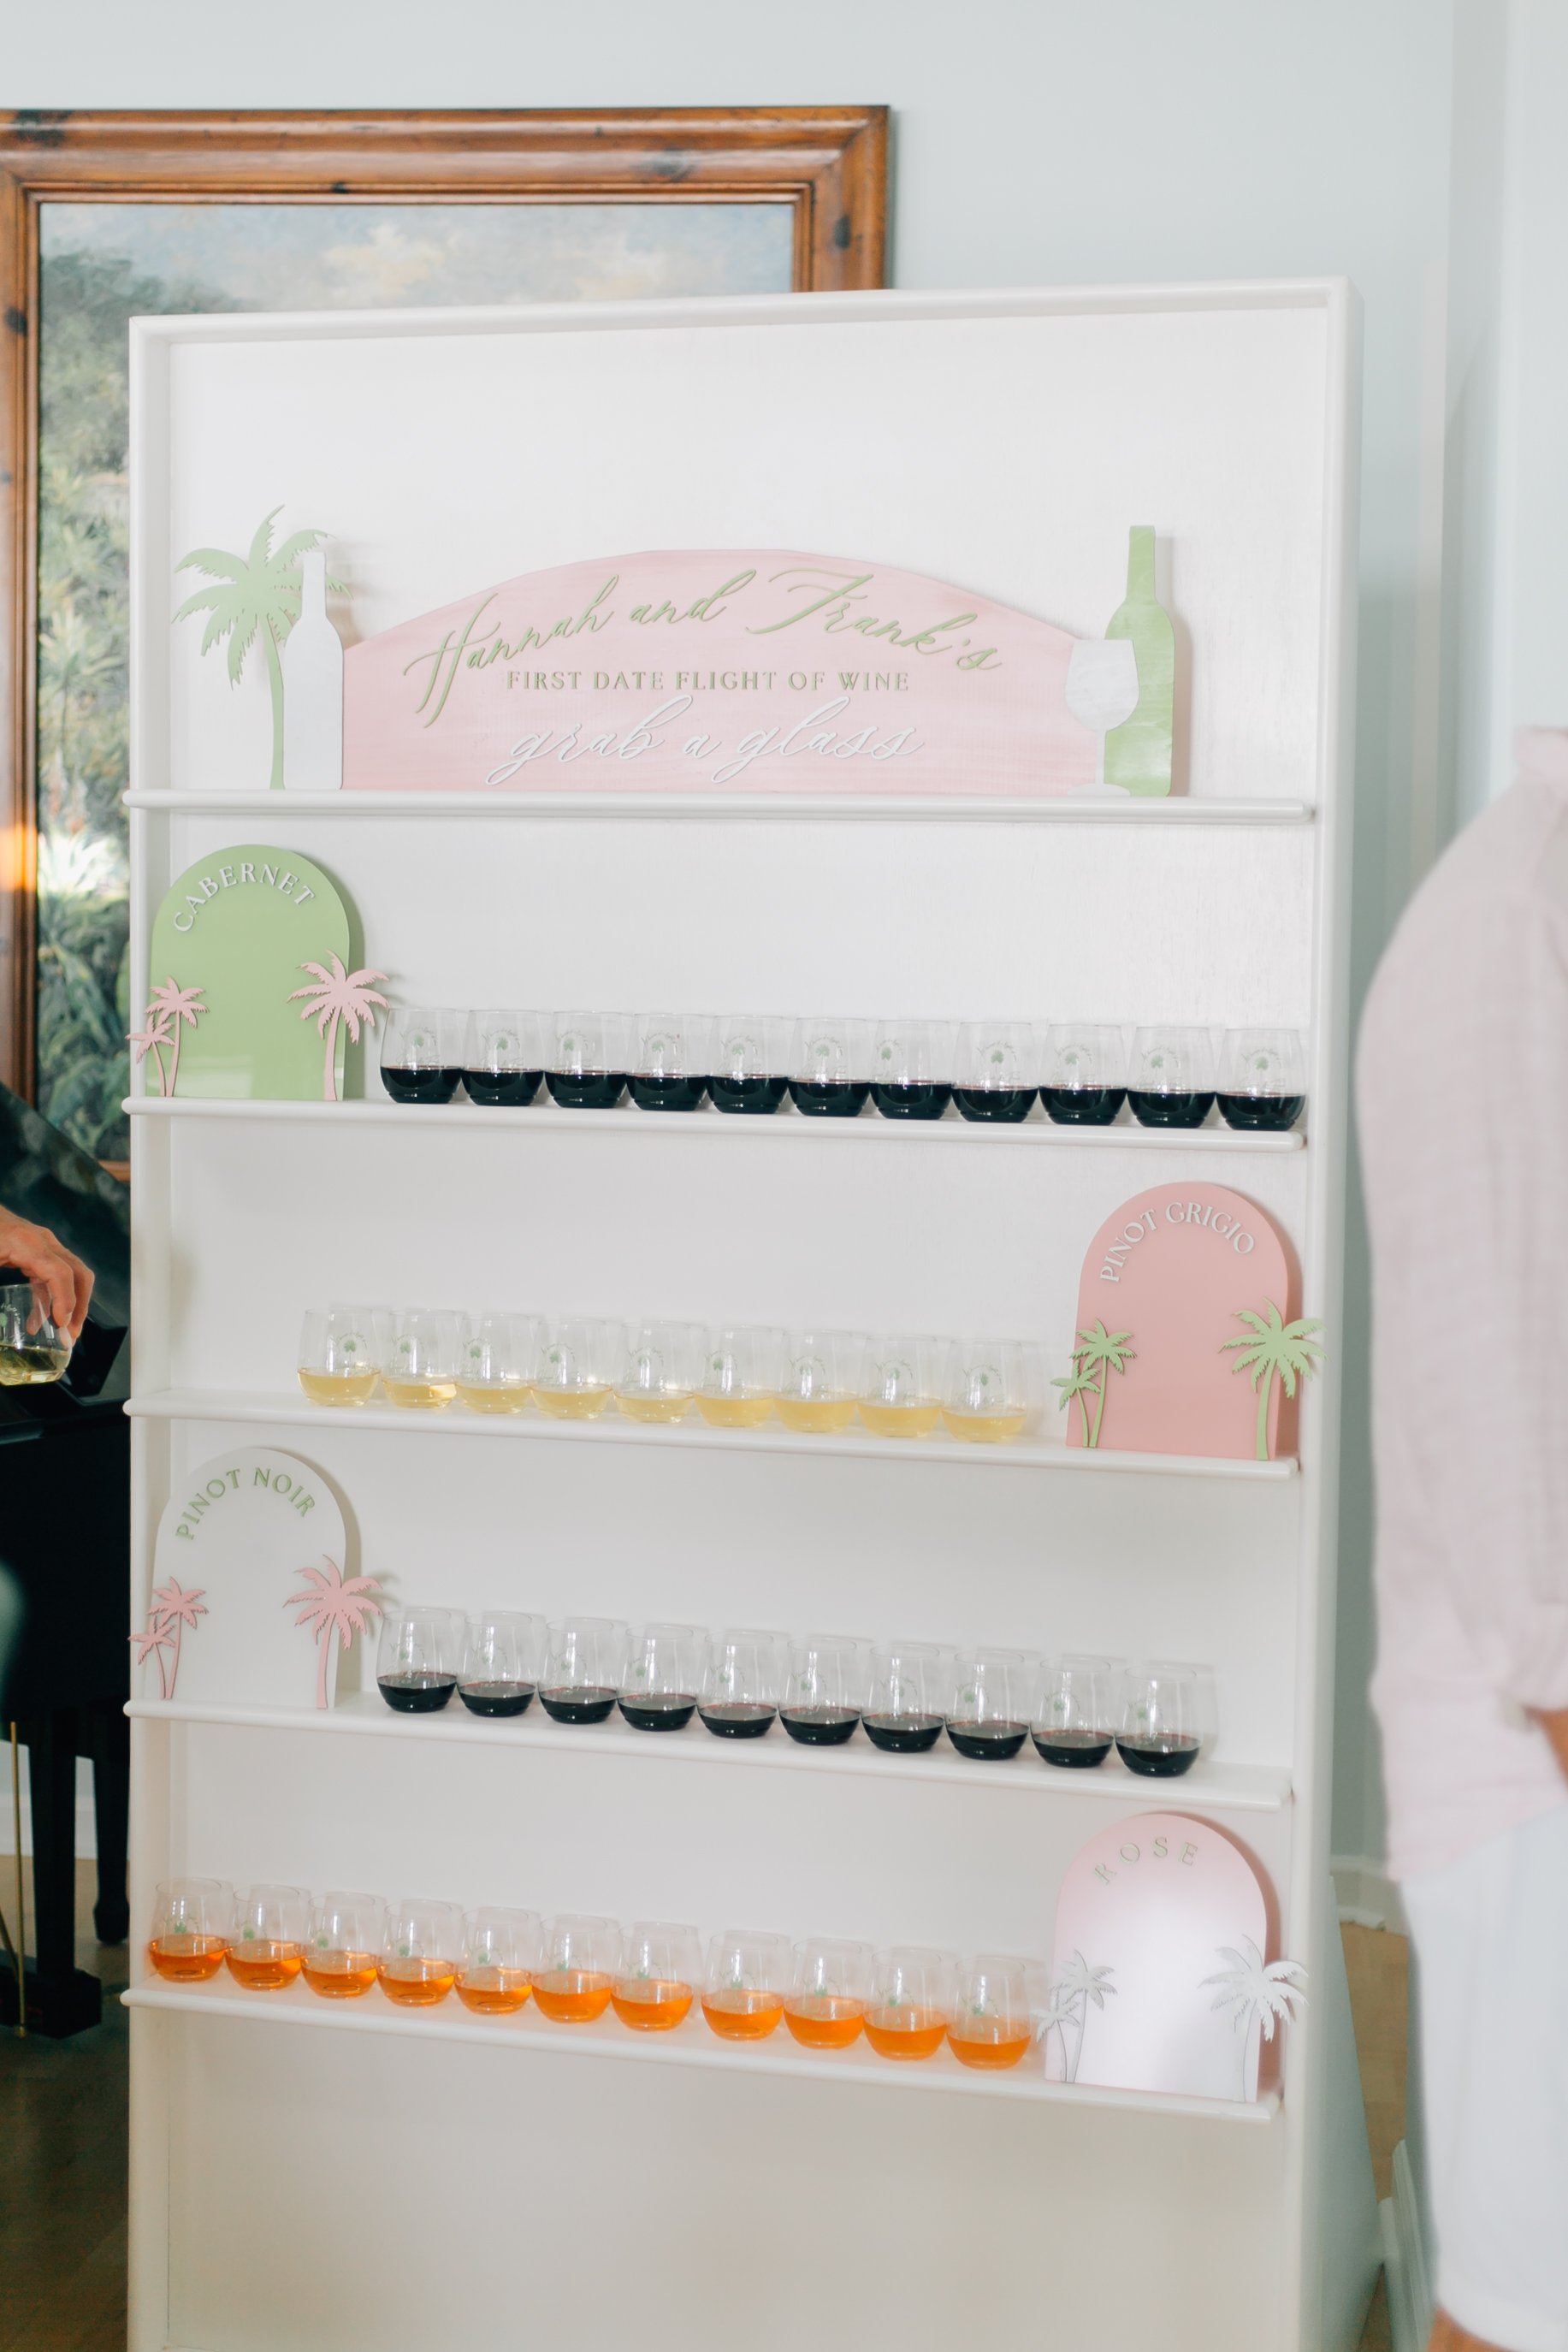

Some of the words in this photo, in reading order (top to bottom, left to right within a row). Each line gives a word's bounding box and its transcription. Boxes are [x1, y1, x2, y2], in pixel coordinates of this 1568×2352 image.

[403, 574, 619, 729] Hannah
[629, 569, 756, 625] and
[746, 568, 1003, 671] Frank's
[506, 671, 582, 690] FIRST
[593, 671, 664, 691] DATE
[674, 672, 777, 691] FLIGHT
[788, 672, 825, 691] OF
[837, 672, 909, 692] WINE
[485, 694, 693, 785] grab
[683, 733, 722, 759] a
[711, 696, 926, 784] glass
[174, 862, 316, 933] CABERNET
[1099, 1208, 1157, 1283] PINOT
[1164, 1201, 1255, 1254] GRIGIO
[175, 1468, 241, 1541] PINOT
[253, 1466, 316, 1518] NOIR
[1093, 1836, 1198, 1886] ROSE
